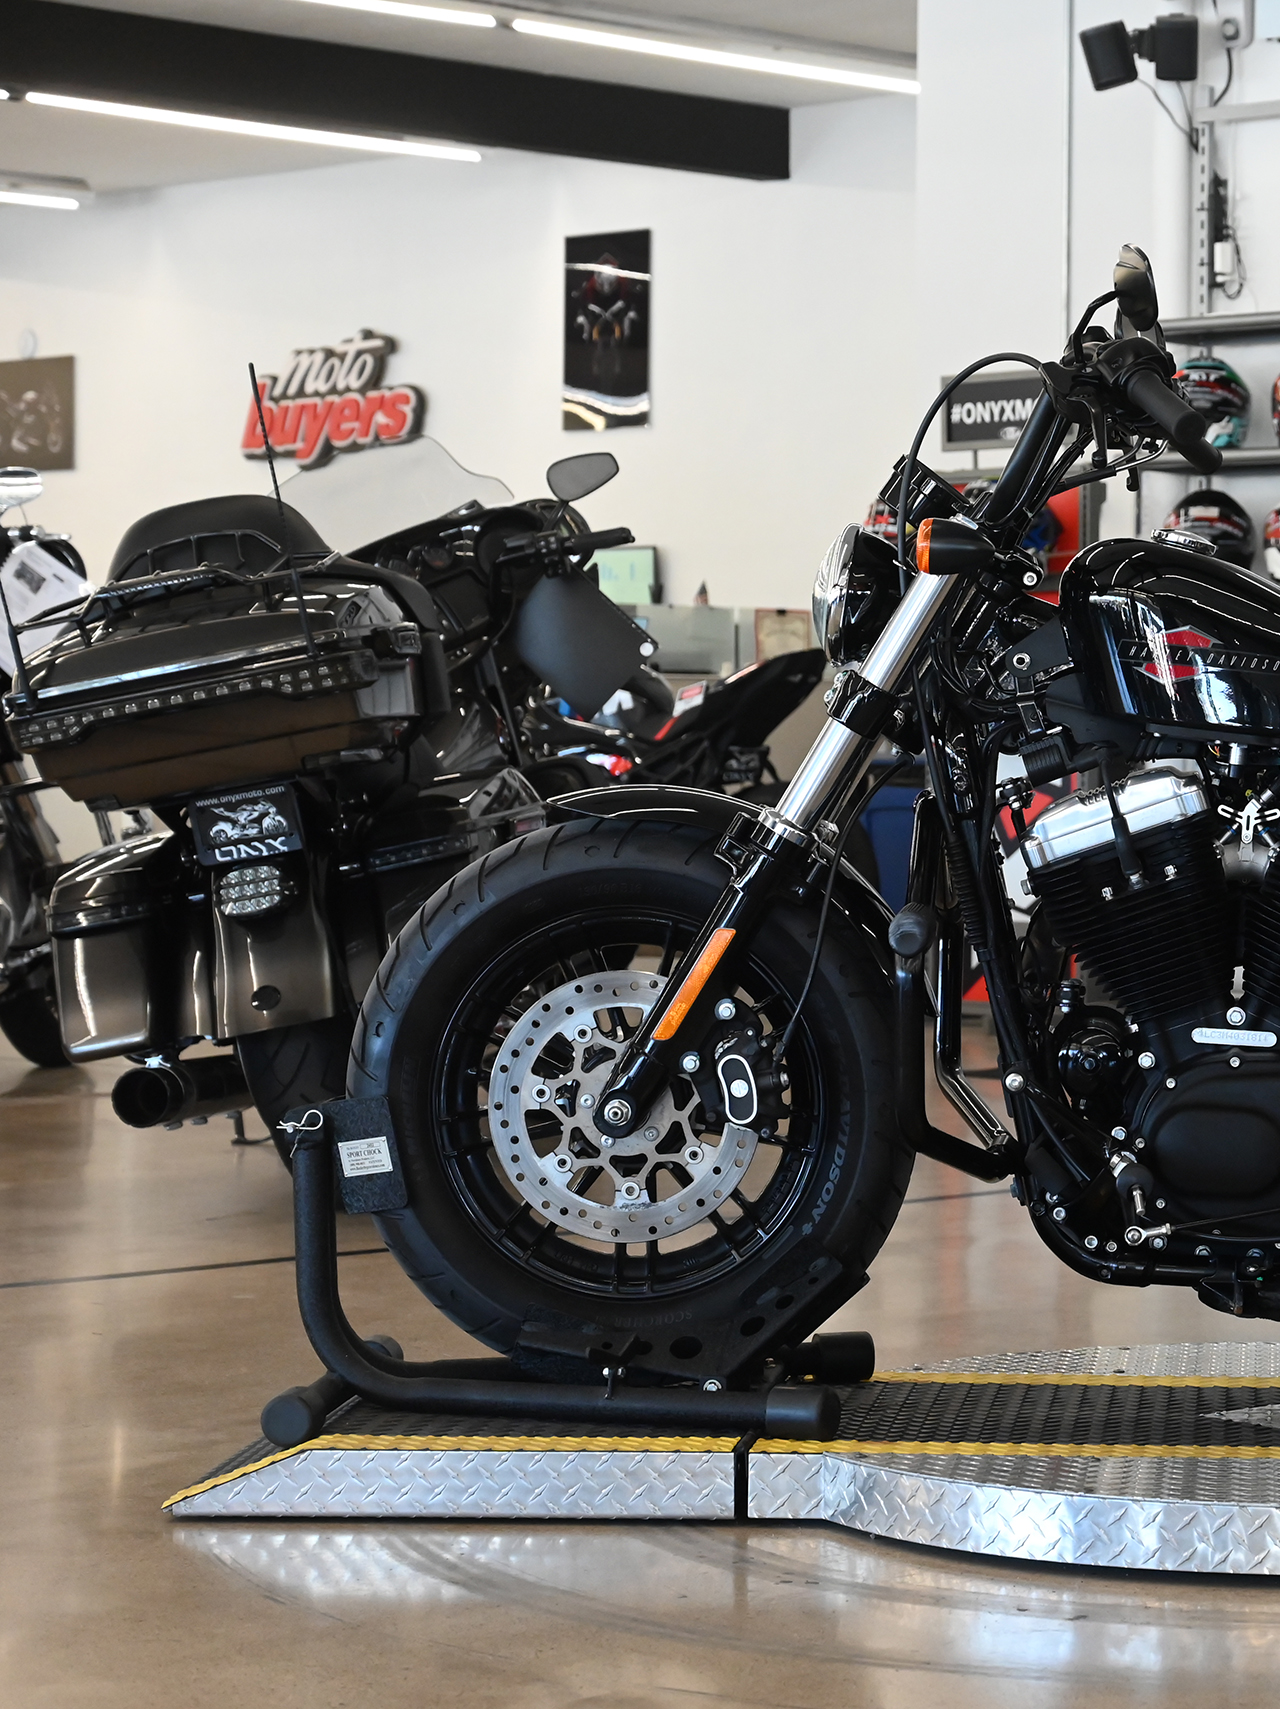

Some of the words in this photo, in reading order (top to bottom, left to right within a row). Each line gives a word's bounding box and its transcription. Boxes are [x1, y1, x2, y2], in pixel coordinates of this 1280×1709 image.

[241, 381, 412, 460] buyers
[951, 398, 1037, 425] #ONYXM
[1129, 645, 1193, 662] HAEY
[195, 785, 285, 807] www.onyxmoto.com
[346, 1149, 362, 1159] SPORT
[363, 1147, 382, 1157] CHOCK
